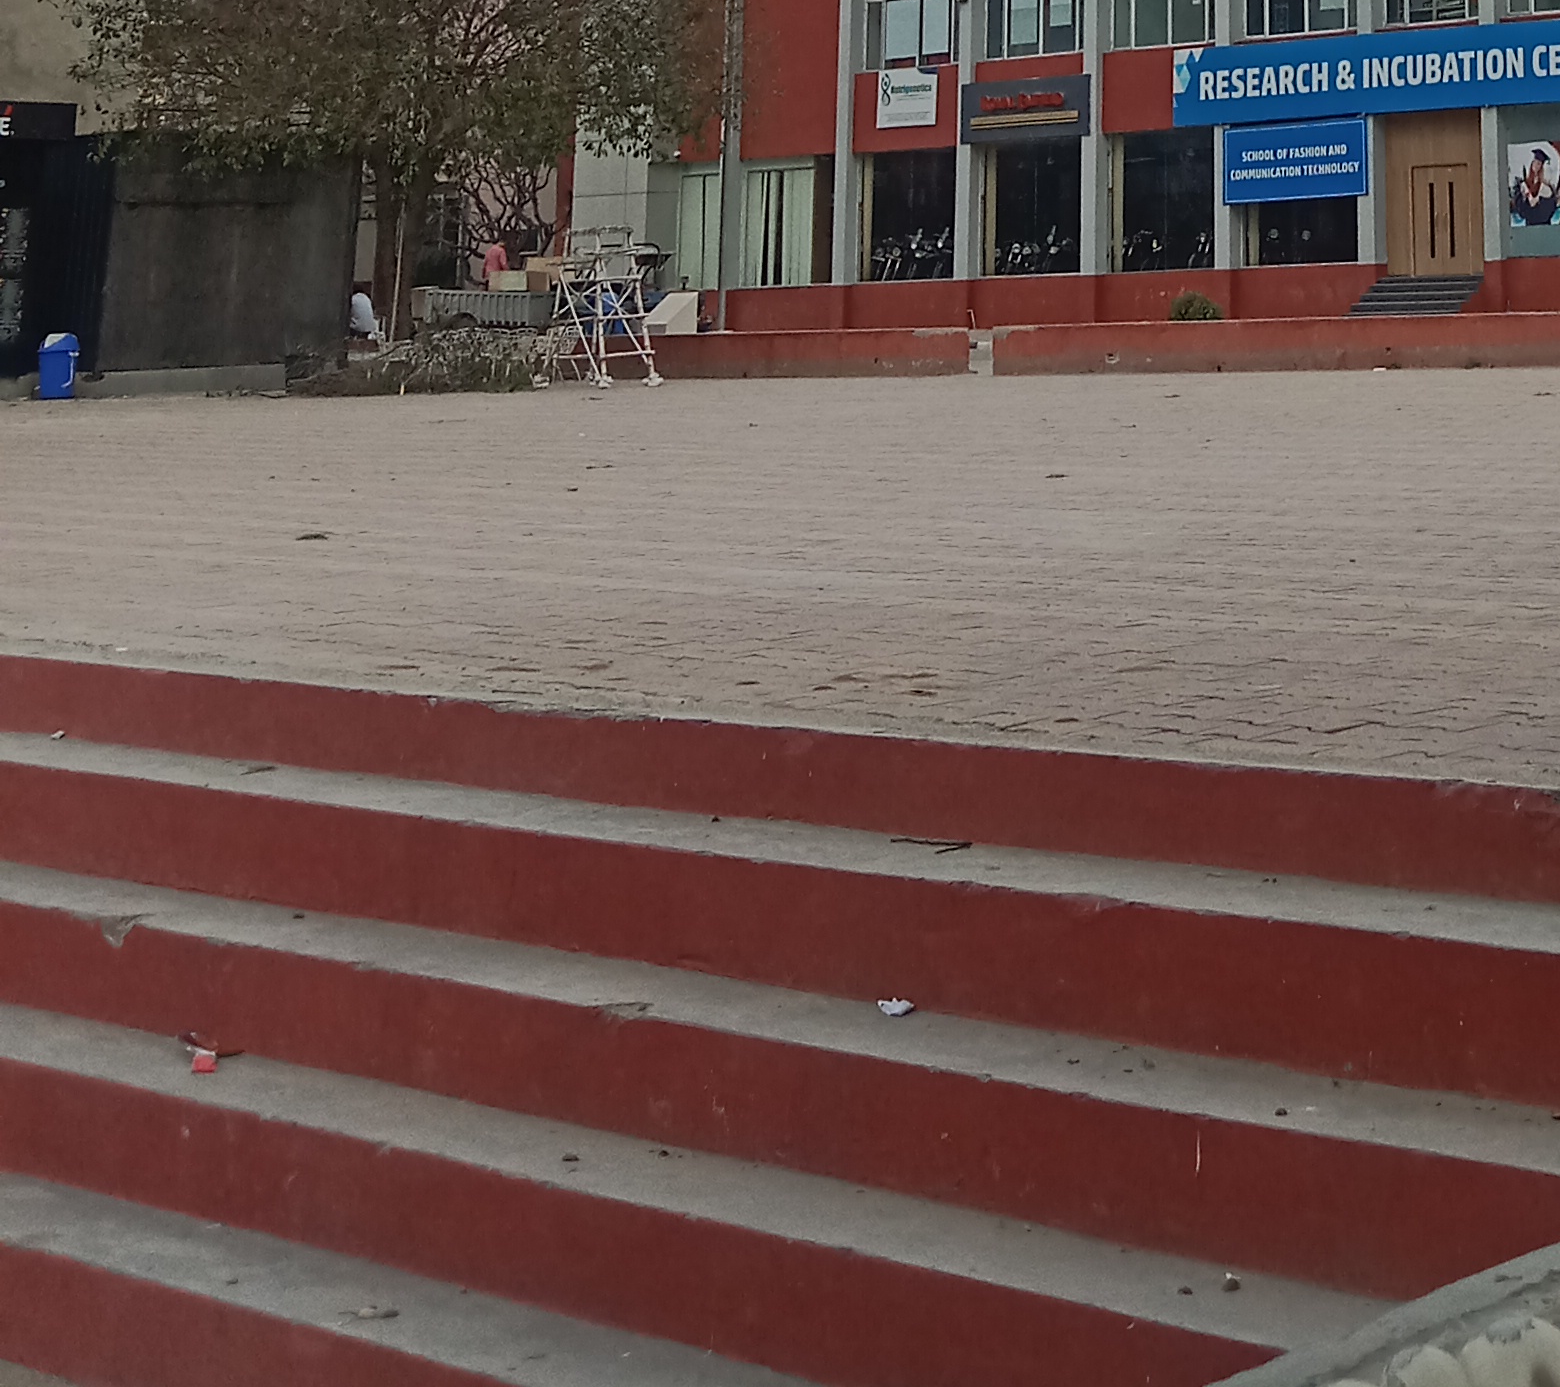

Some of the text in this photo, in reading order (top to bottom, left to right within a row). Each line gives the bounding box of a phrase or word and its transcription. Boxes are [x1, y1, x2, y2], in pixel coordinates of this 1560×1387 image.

[1199, 61, 1329, 101] RESEARCH
[1336, 59, 1355, 90] &
[1362, 47, 1524, 88] INCUBATION
[1242, 144, 1347, 163] SCHOOL OF FASHION AND
[1230, 161, 1360, 181] COMMUNICATION TECHNOLOGY
